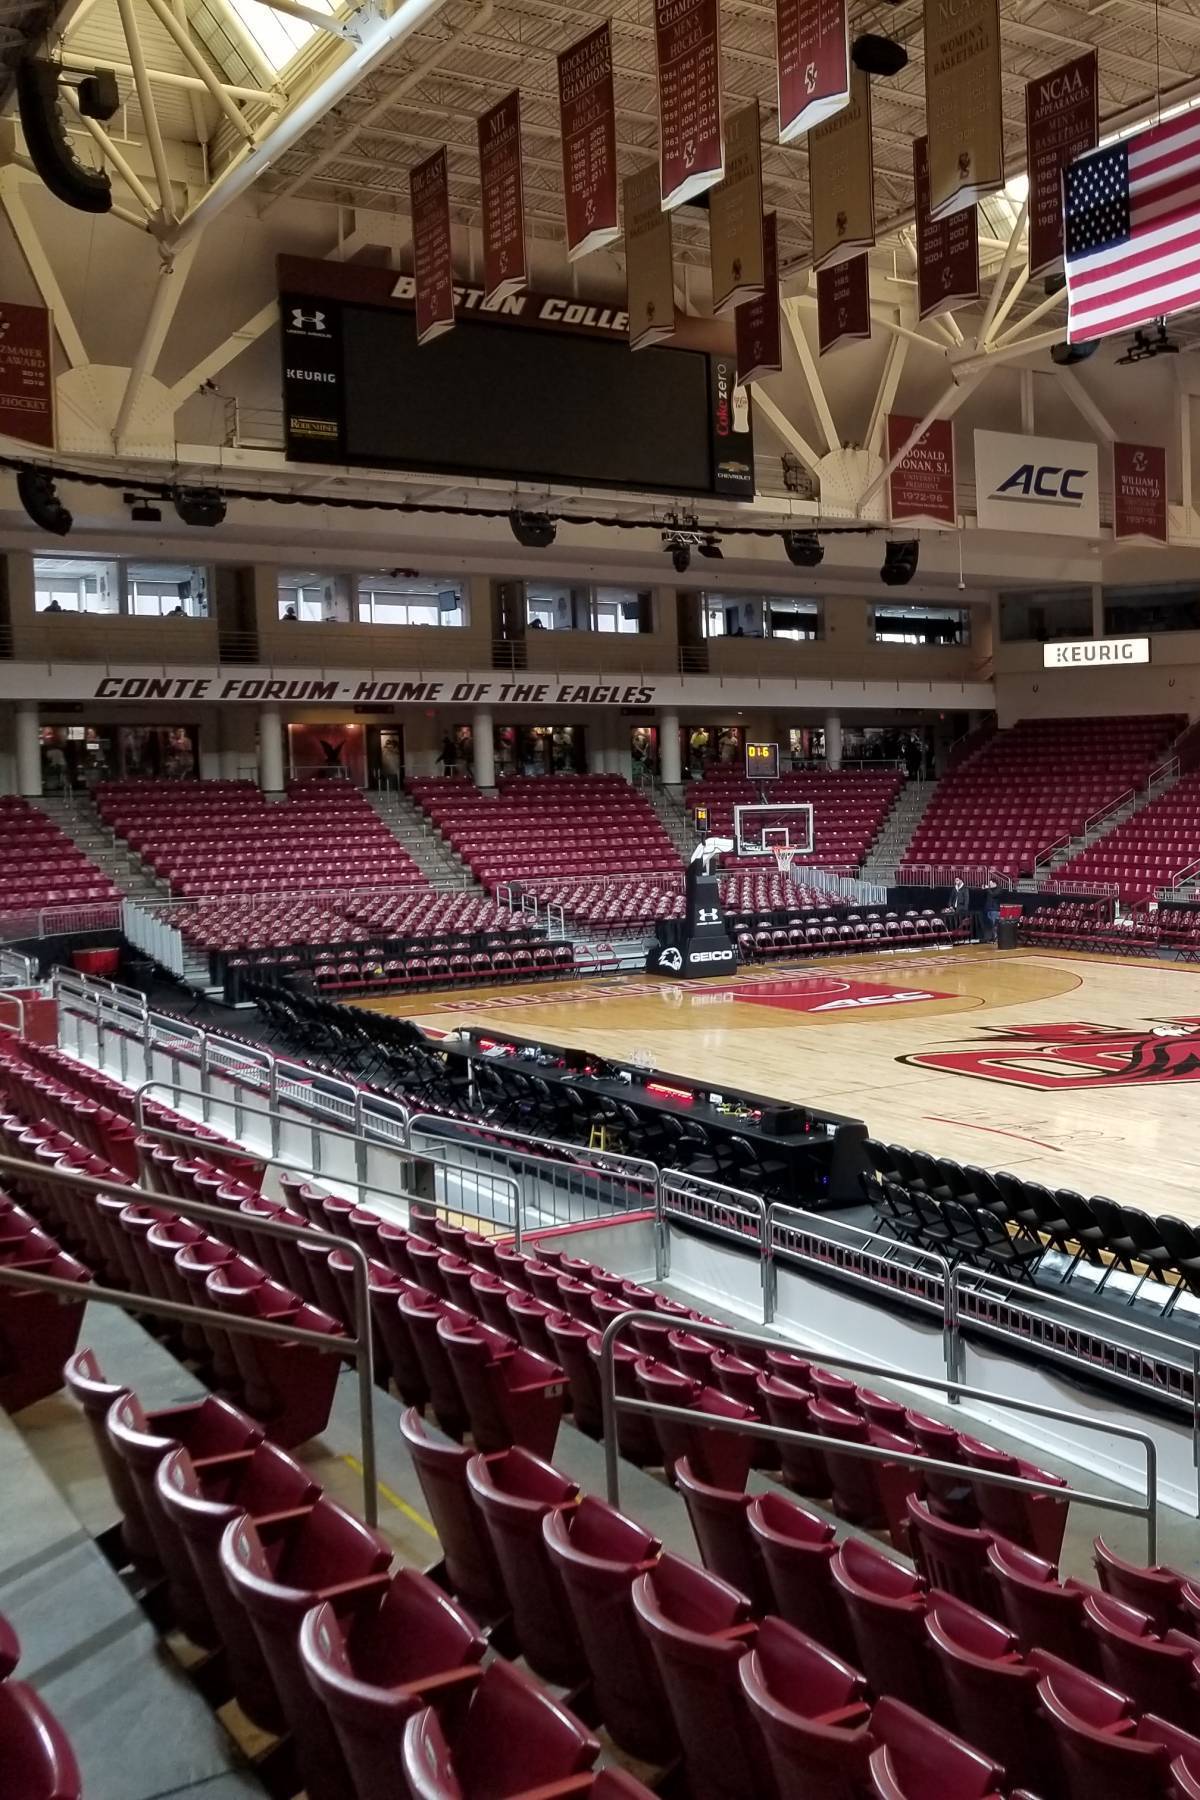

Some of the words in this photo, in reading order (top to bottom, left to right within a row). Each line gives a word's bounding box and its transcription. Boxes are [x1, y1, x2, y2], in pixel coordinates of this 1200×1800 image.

[670, 27, 703, 58] HOCKEY
[940, 21, 984, 54] WOMEN'S
[561, 46, 589, 76] HOCKEY
[589, 30, 609, 55] EAST
[933, 35, 990, 75] BASKETBALL
[562, 46, 610, 89] TOURNAMENT
[562, 60, 611, 103] CHAMPIONS
[1040, 69, 1083, 106] NCAA
[1035, 86, 1090, 121] APPEARANCES
[489, 108, 507, 138] NIT
[1049, 111, 1077, 130] MEN'S
[699, 125, 717, 142] 2016
[1034, 119, 1090, 151] BASKETBALL
[1069, 138, 1088, 155] 1982
[1038, 198, 1058, 213] 1975
[1038, 214, 1057, 229] 1981
[5, 355, 46, 368] AWARD
[286, 368, 336, 383] KEURIG
[717, 363, 728, 399] zero
[0, 396, 46, 411] HOCKEY
[717, 400, 729, 436] Coke
[936, 462, 951, 474] S.J.
[995, 463, 1089, 500] ACC
[1121, 475, 1154, 486] WILLIAM
[1121, 485, 1148, 497] FLYNN
[1057, 644, 1133, 663] KEURIG
[94, 678, 212, 699] CONTE
[220, 680, 339, 700] FORUM
[353, 682, 444, 701] HOME
[450, 684, 492, 701] OF
[498, 685, 550, 702] THE
[556, 685, 656, 704] EAGLES
[690, 950, 733, 963] GEICO
[808, 991, 934, 1012] ACC
